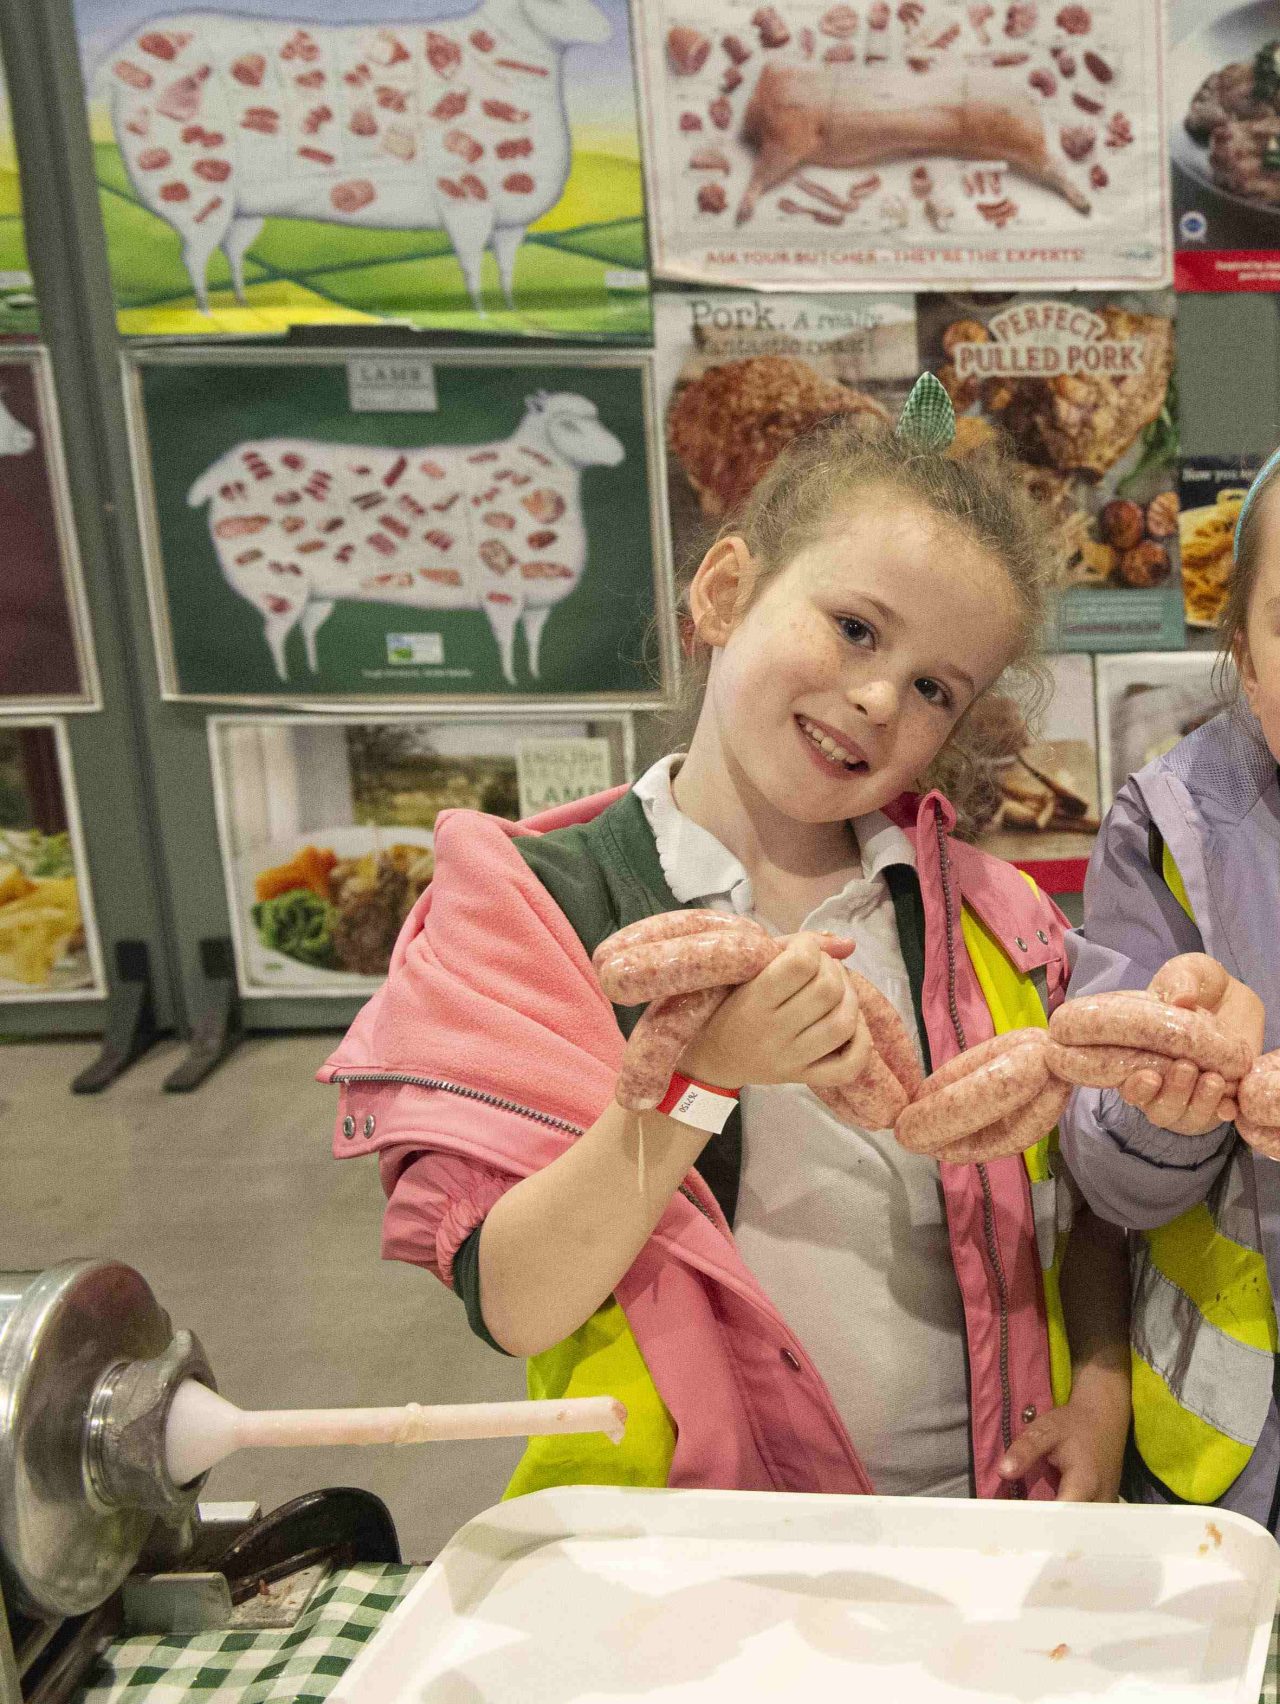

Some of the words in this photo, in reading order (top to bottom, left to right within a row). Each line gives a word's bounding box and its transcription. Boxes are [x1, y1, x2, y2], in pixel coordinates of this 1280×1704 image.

[744, 252, 789, 264] YOUR
[794, 251, 876, 264] BUTCHER
[895, 248, 962, 263] THEY'RE
[967, 248, 1000, 262] THE
[690, 300, 786, 331] Pork.
[794, 313, 809, 330] A
[817, 311, 884, 332] really
[995, 306, 1102, 341] PERFECT
[960, 346, 1059, 371] PULLED
[1067, 345, 1138, 370] PORK
[361, 366, 421, 381] LAMB
[1214, 470, 1238, 483] you
